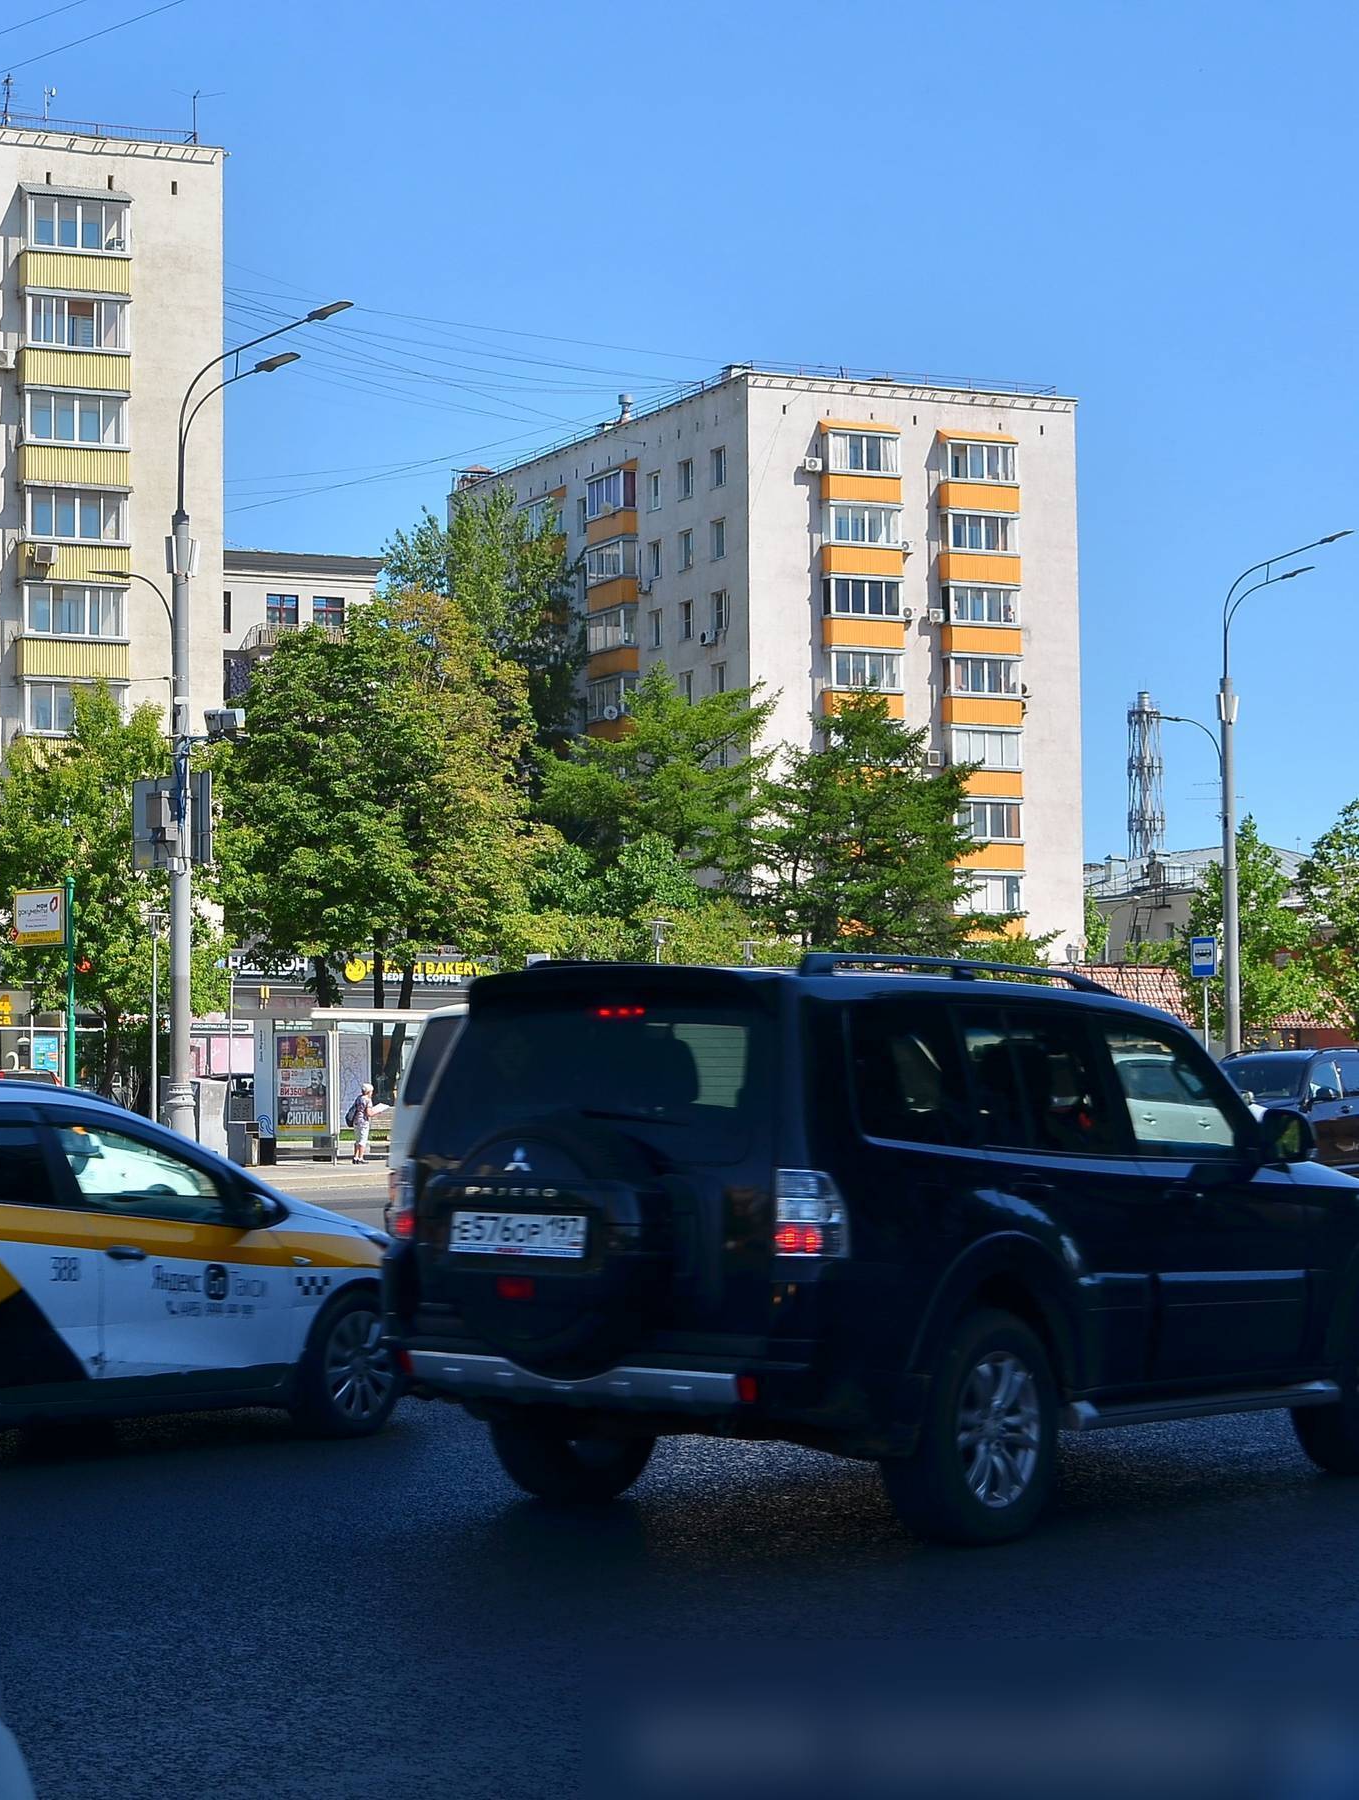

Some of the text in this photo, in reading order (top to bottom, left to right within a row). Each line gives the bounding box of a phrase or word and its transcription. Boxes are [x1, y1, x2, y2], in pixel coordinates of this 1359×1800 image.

[425, 961, 482, 977] BAKERY
[426, 974, 461, 982] COFFEE
[286, 1111, 324, 1125] СЮТКИН
[464, 1185, 559, 1198] PAJERO
